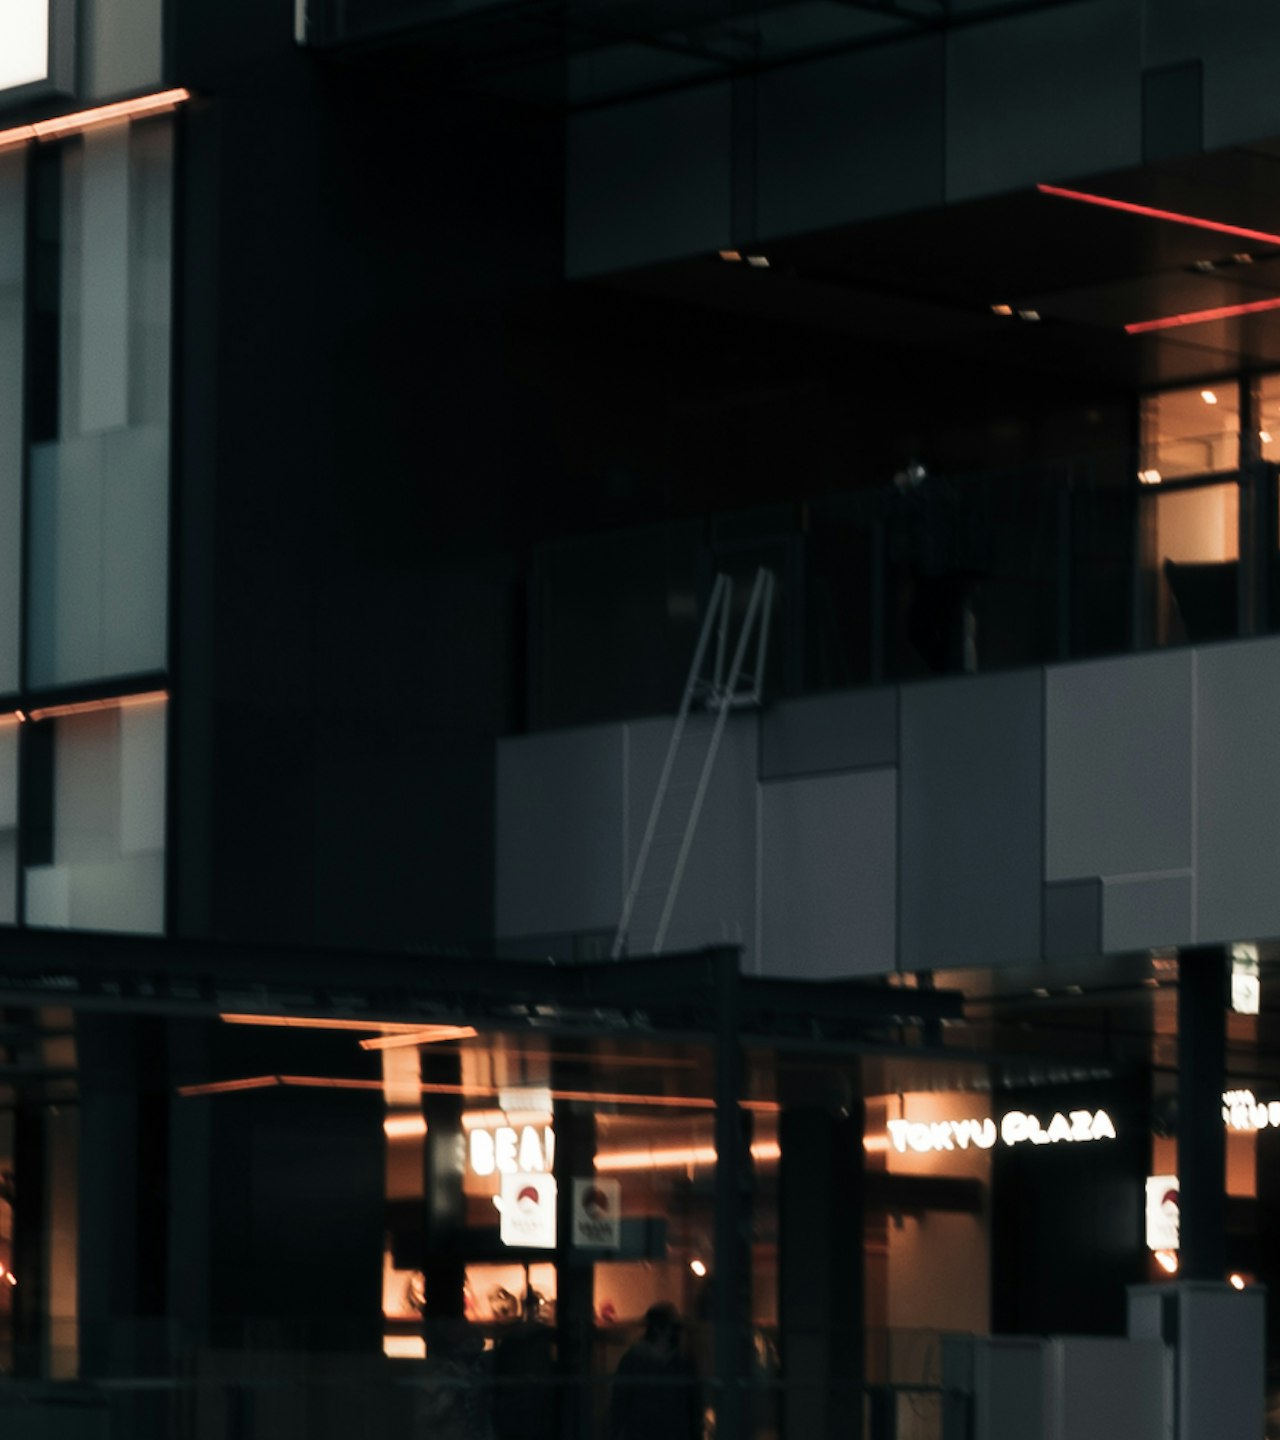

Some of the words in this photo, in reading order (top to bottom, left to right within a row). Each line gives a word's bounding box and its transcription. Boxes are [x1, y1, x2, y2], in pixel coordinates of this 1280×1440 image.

[469, 1124, 556, 1176] BEA
[887, 1118, 998, 1154] TOKYU
[1000, 1109, 1117, 1147] PLAZA
